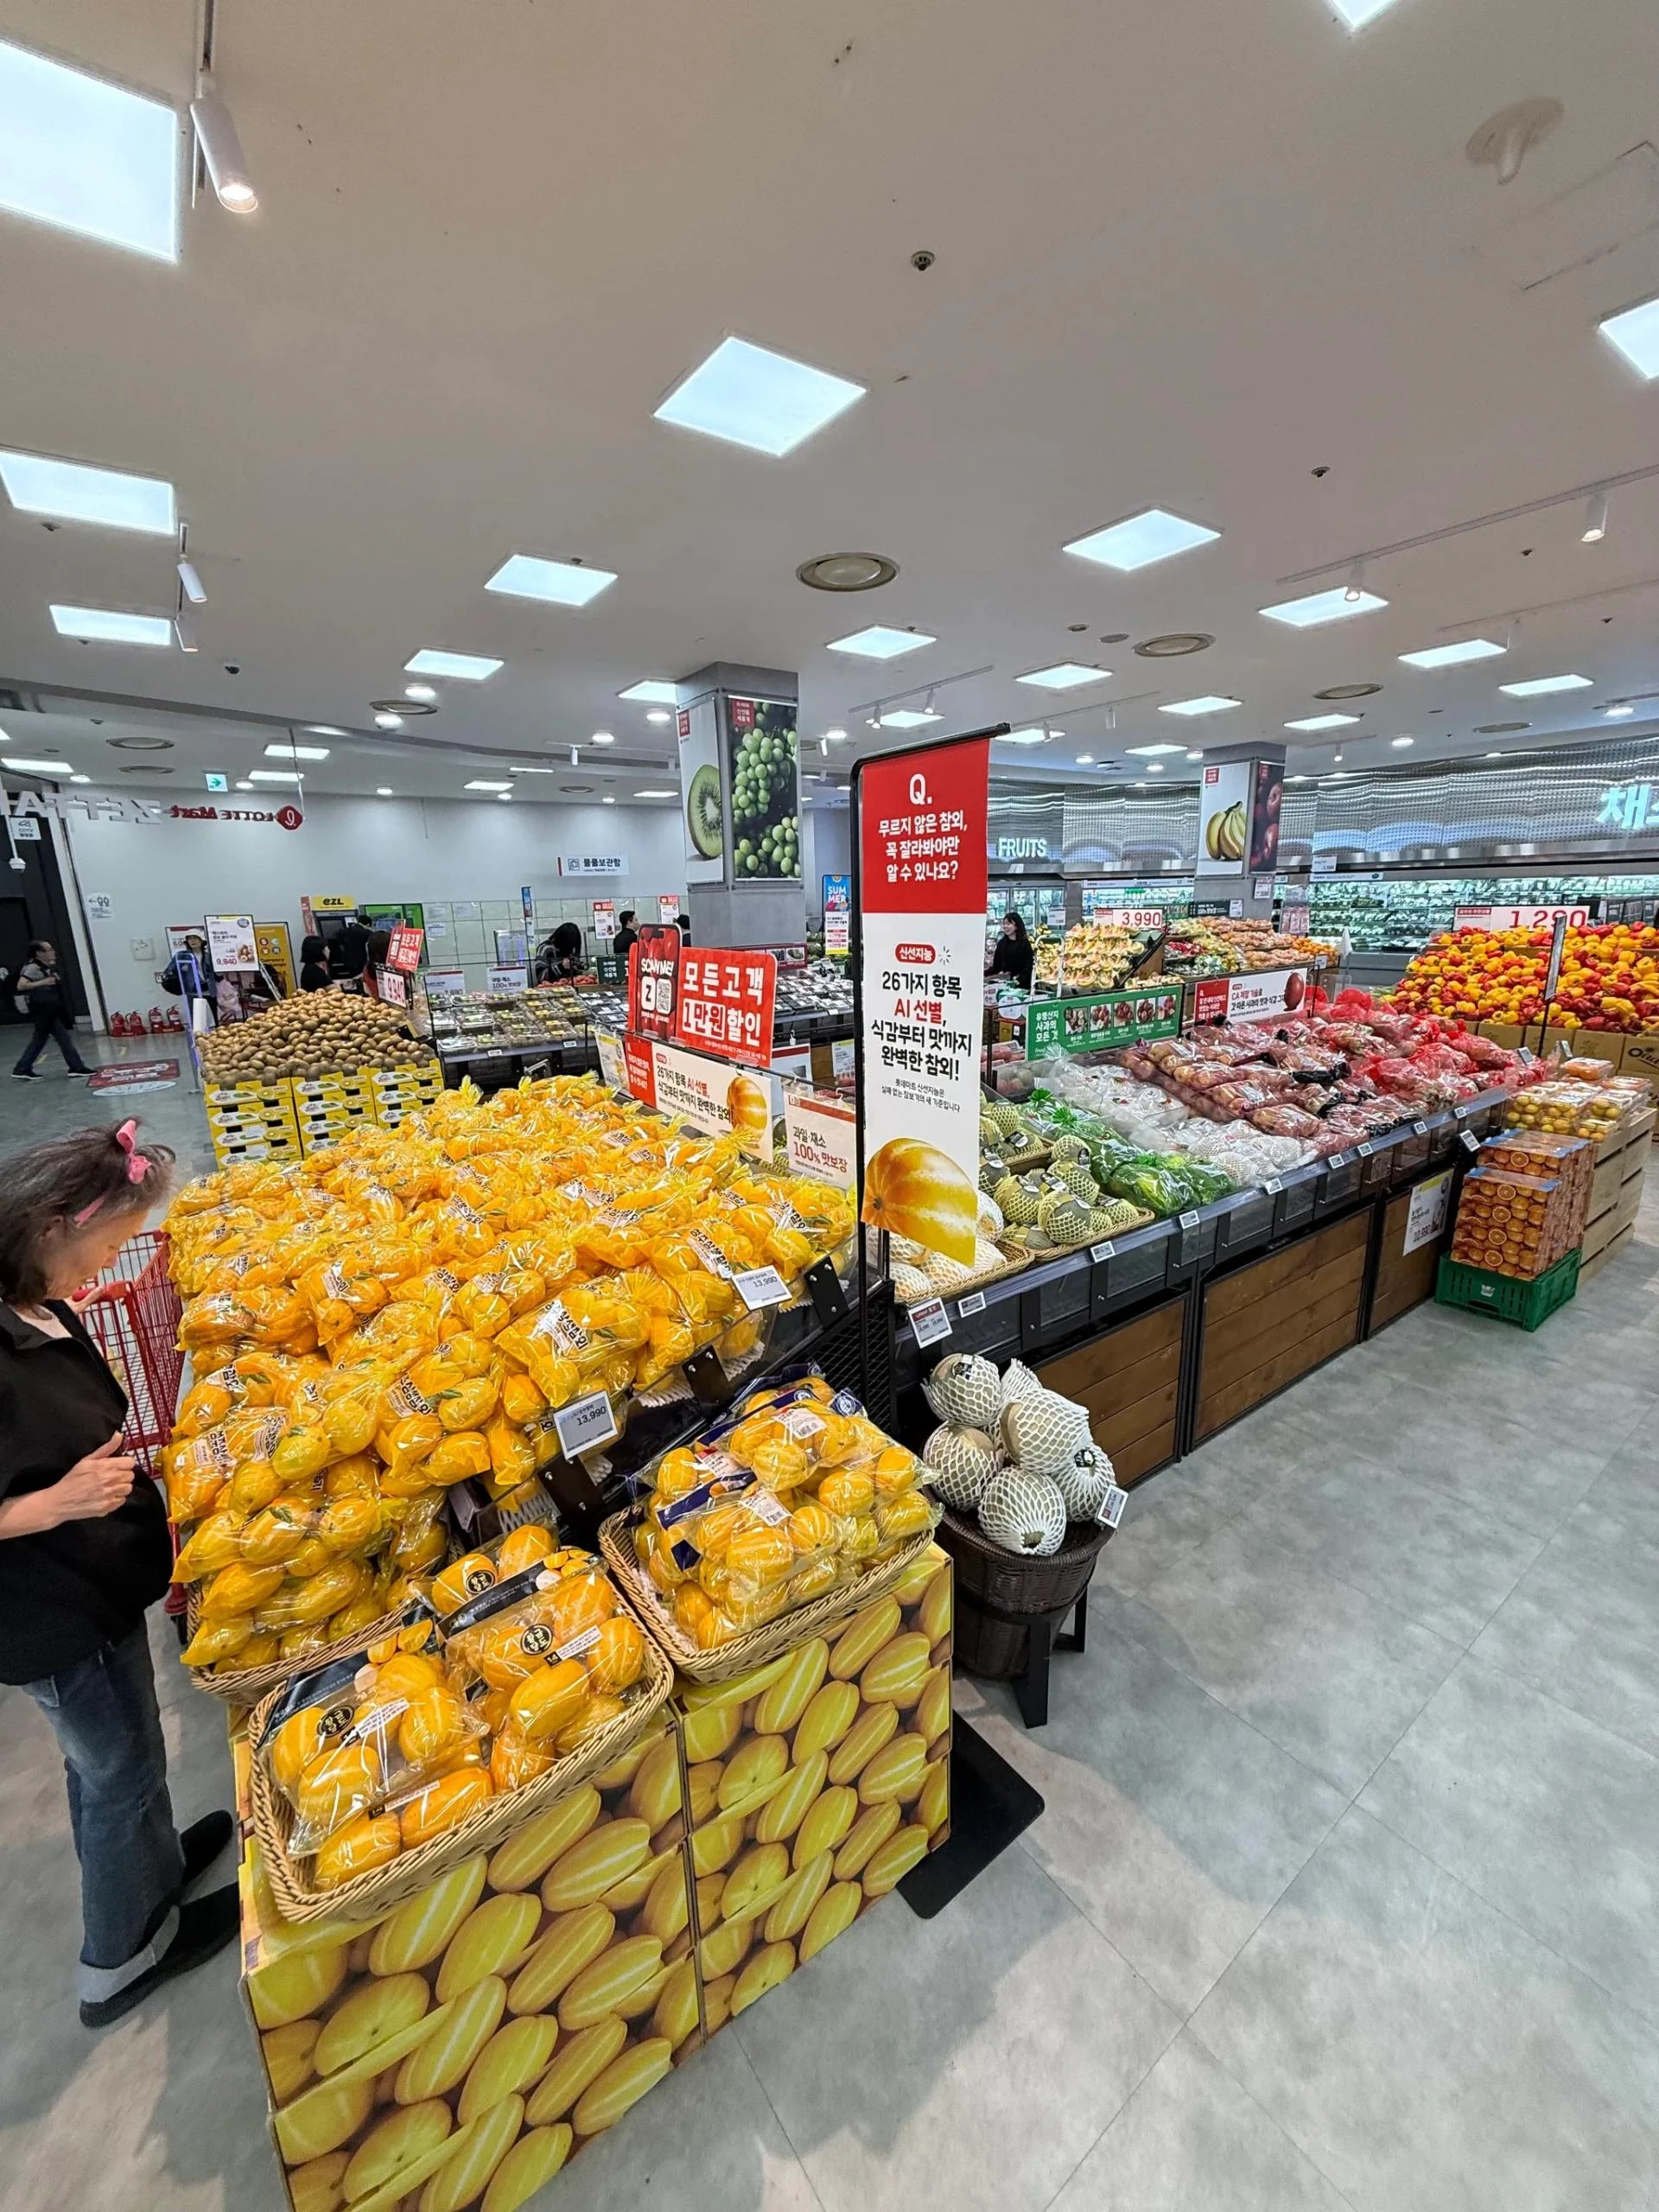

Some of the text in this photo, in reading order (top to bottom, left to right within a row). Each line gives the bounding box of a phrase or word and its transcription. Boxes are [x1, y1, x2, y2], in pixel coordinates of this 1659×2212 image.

[909, 773, 932, 805] Q.
[1597, 785, 1659, 830] 채
[879, 810, 968, 838] 무르지 않은 참외,
[886, 836, 960, 860] 꼭 잘라봐야만
[998, 836, 1047, 858] FRUITS
[583, 858, 621, 867] 물품보관함
[887, 860, 959, 883] 알 수 있나요?
[828, 885, 847, 895] SUM
[828, 894, 847, 904] MER
[1122, 912, 1161, 926] 3,990
[899, 947, 933, 962] 신선지능
[882, 971, 962, 1000] 26가지 항목
[894, 999, 947, 1027] AI 선별,
[1036, 1020, 1057, 1031] 사과의
[871, 1020, 972, 1058] 식감부터 맛까지
[1036, 1032, 1050, 1042] 모든
[881, 1046, 960, 1081] 완벽한 참외!
[657, 1065, 674, 1082] 26가지
[687, 1077, 695, 1090] AI
[794, 1141, 821, 1164] 100%
[821, 1152, 849, 1173] 맛보장
[753, 1276, 778, 1287] 13,990
[576, 1406, 607, 1426] 13,990
[547, 1654, 559, 1663] 14
